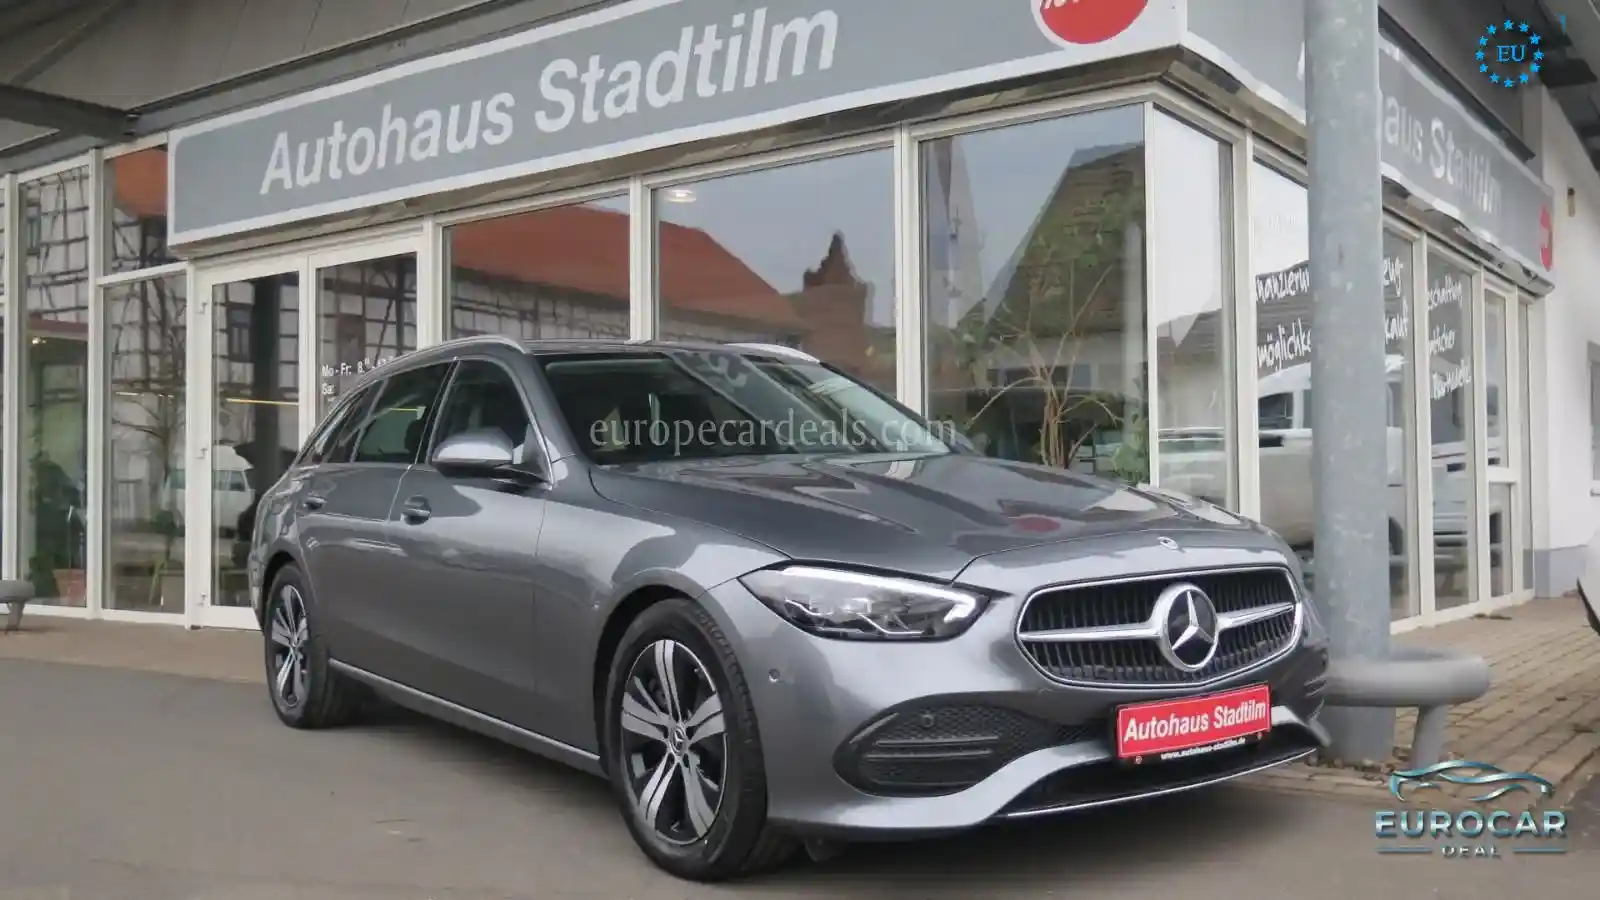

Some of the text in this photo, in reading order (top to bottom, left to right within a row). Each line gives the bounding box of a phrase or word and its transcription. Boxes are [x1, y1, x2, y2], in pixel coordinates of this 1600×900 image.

[259, 7, 839, 196] Autohaus Stadtilm
[1381, 96, 1422, 165] aus
[1123, 698, 1267, 743] Autohaus Stadtilm
